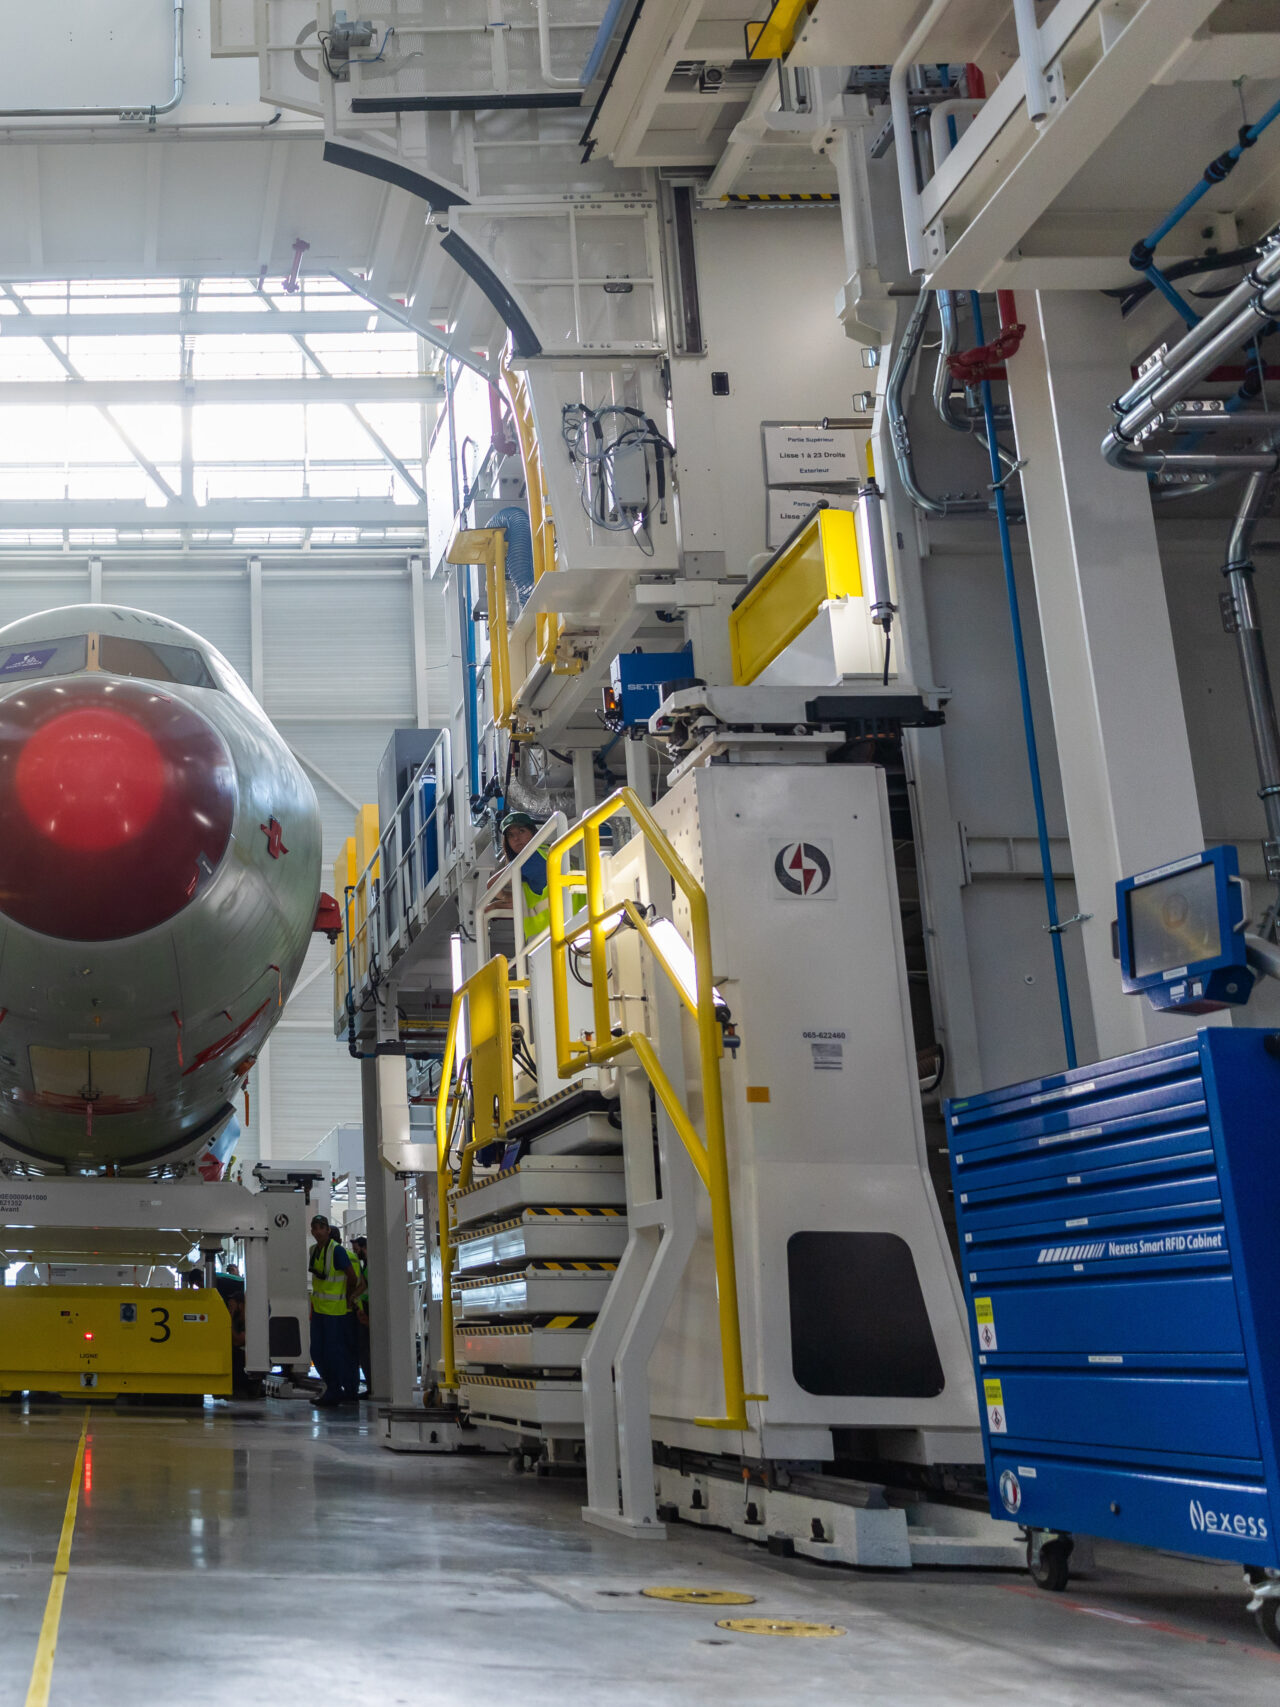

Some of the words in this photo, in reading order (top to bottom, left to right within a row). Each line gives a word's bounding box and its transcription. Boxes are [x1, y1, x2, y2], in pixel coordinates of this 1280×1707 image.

[1108, 1240, 1138, 1256] Nexess
[1139, 1239, 1164, 1253] Smart
[1165, 1236, 1186, 1251] RFID
[1186, 1233, 1222, 1249] Cabinet
[150, 1307, 171, 1344] 3
[1189, 1499, 1268, 1538] Nexess
